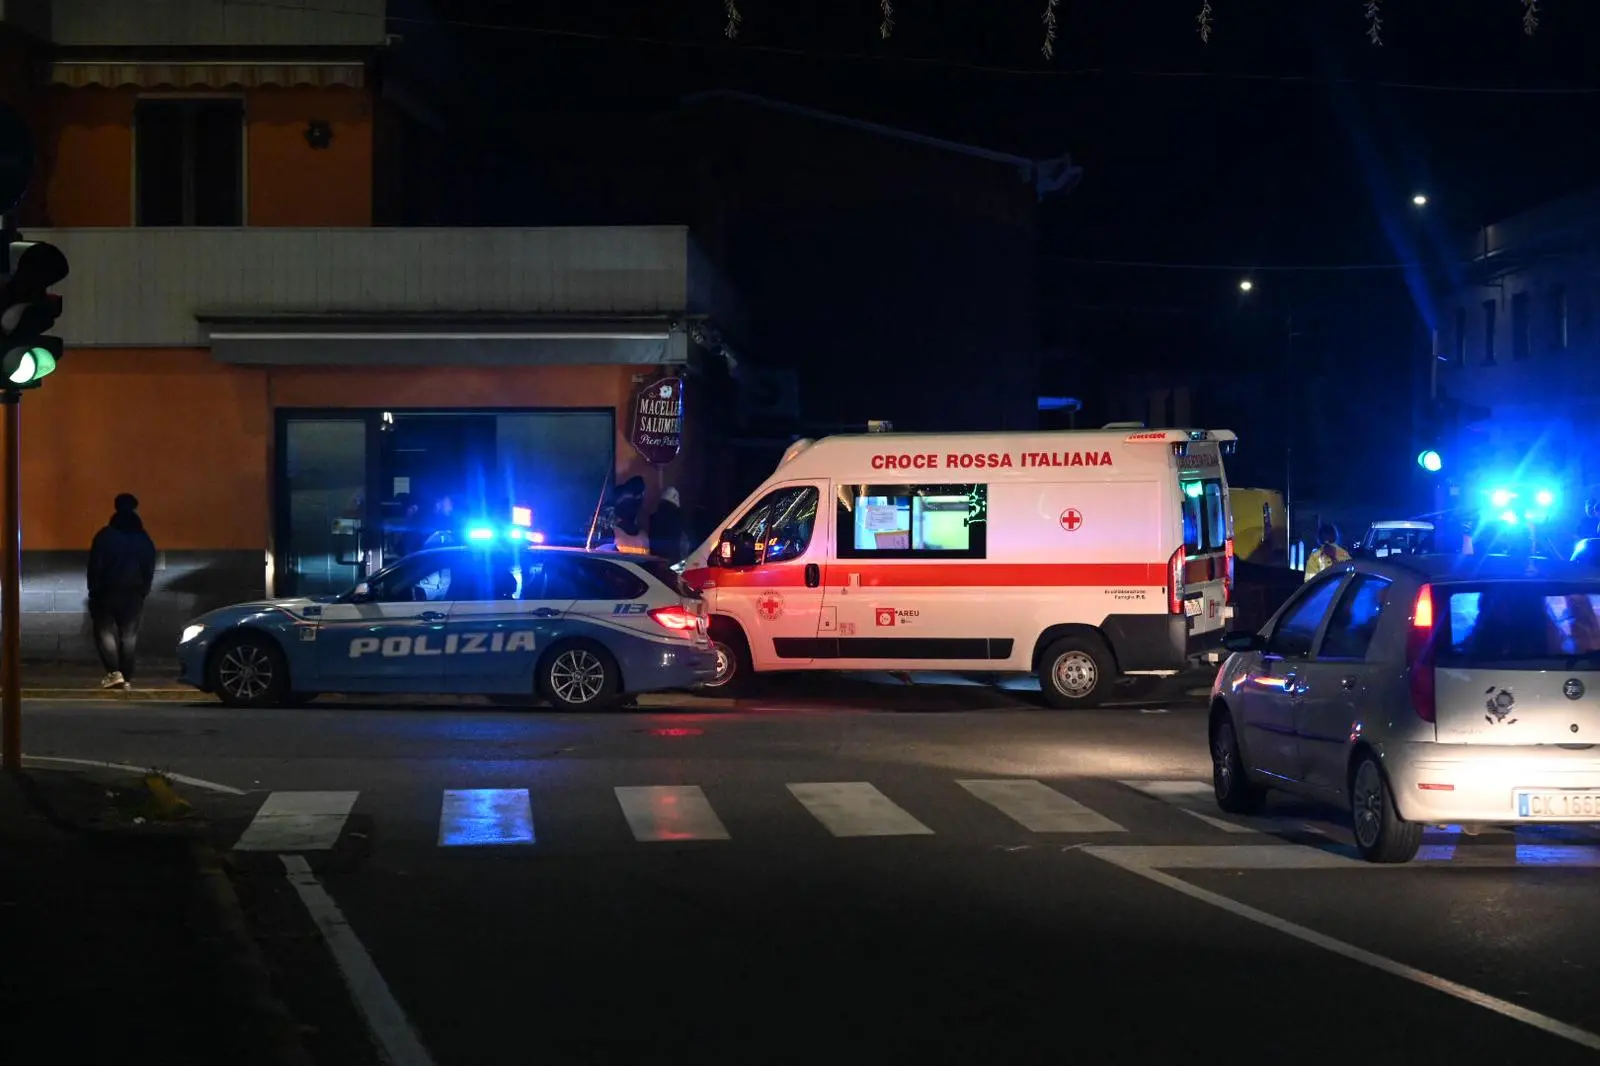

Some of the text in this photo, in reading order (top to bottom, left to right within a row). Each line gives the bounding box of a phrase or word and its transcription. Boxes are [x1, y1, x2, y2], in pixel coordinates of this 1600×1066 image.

[871, 451, 1113, 469] CROCE ROSSA ITALIANA
[613, 603, 649, 614] 113
[349, 631, 536, 658] POLIZIA
[1532, 795, 1555, 815] CK
